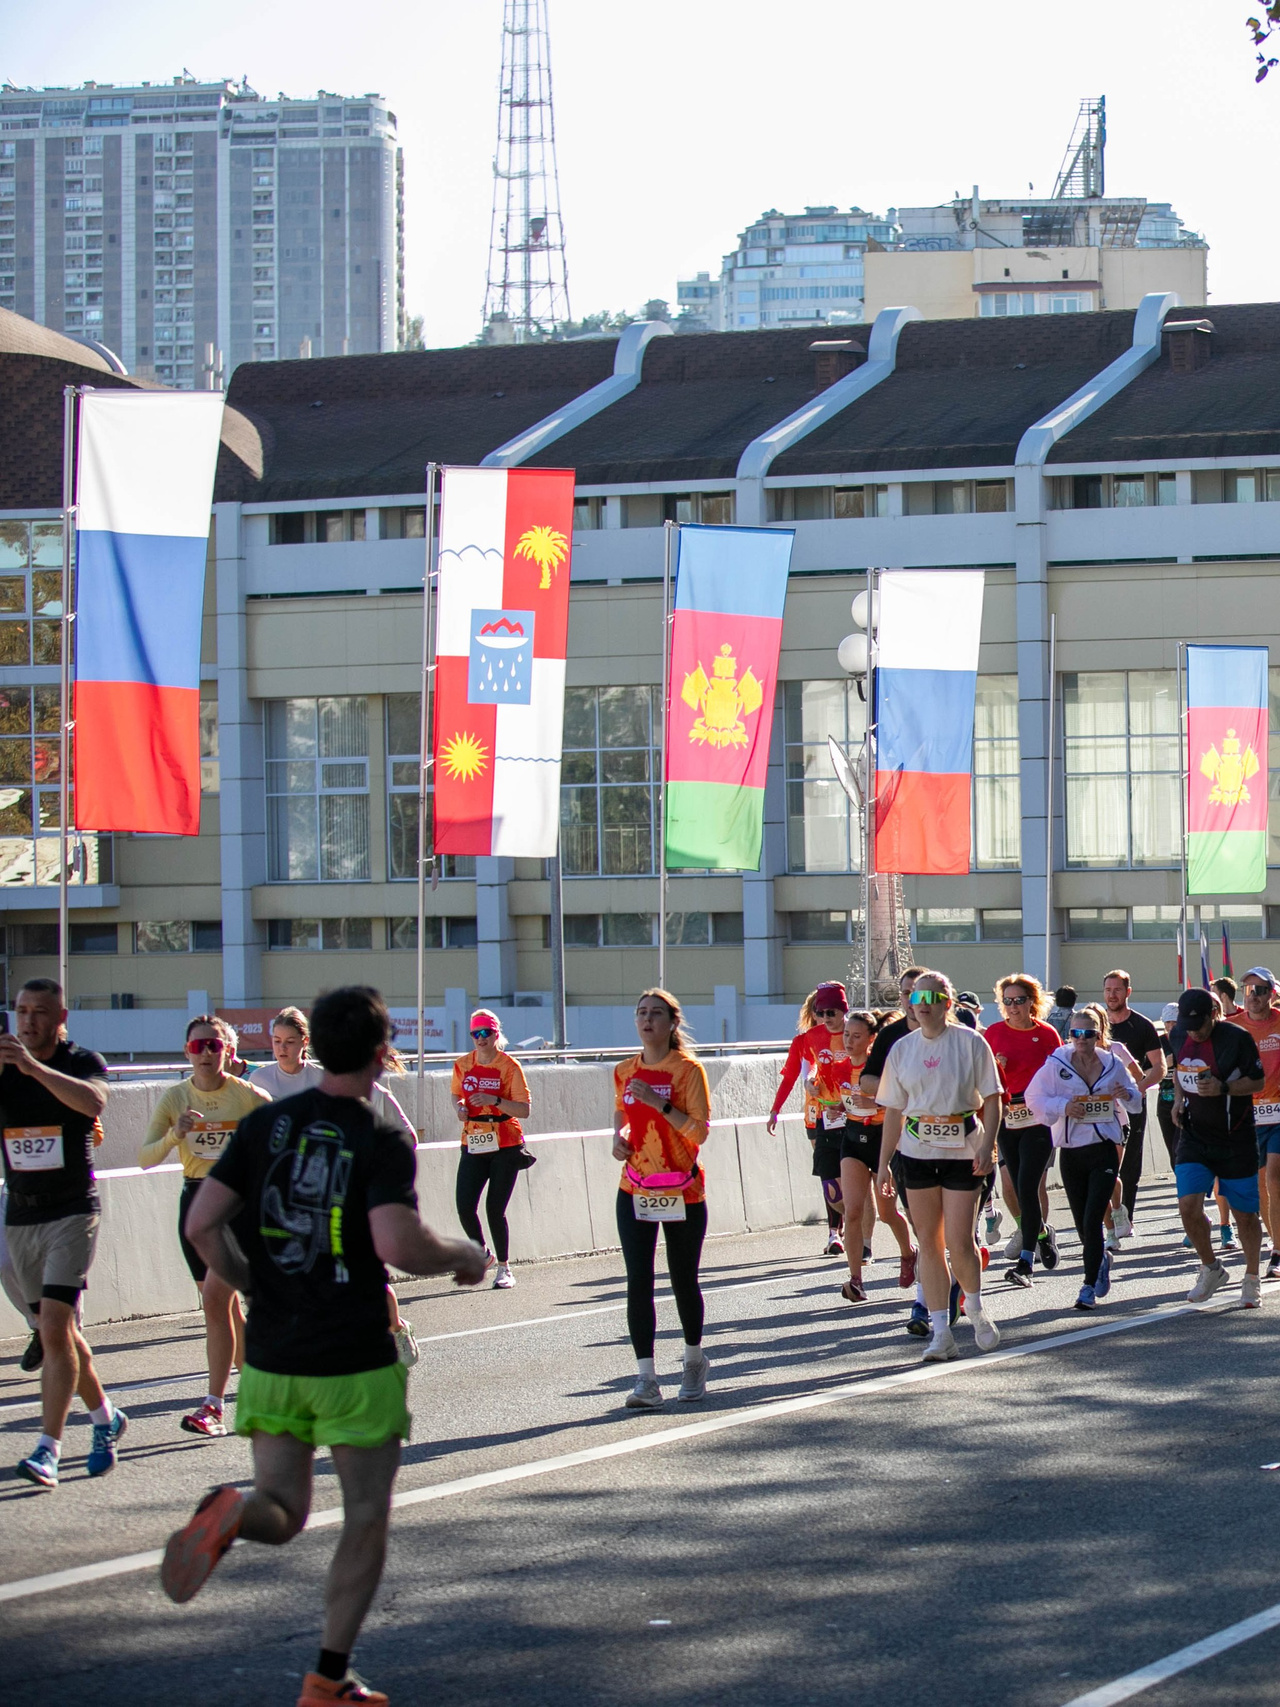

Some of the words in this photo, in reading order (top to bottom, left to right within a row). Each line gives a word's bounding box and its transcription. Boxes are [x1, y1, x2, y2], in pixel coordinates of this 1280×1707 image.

[923, 1124, 960, 1136] 3529
[469, 1133, 494, 1144] 3509
[12, 1138, 56, 1155] 3827
[640, 1196, 678, 1208] 3207
